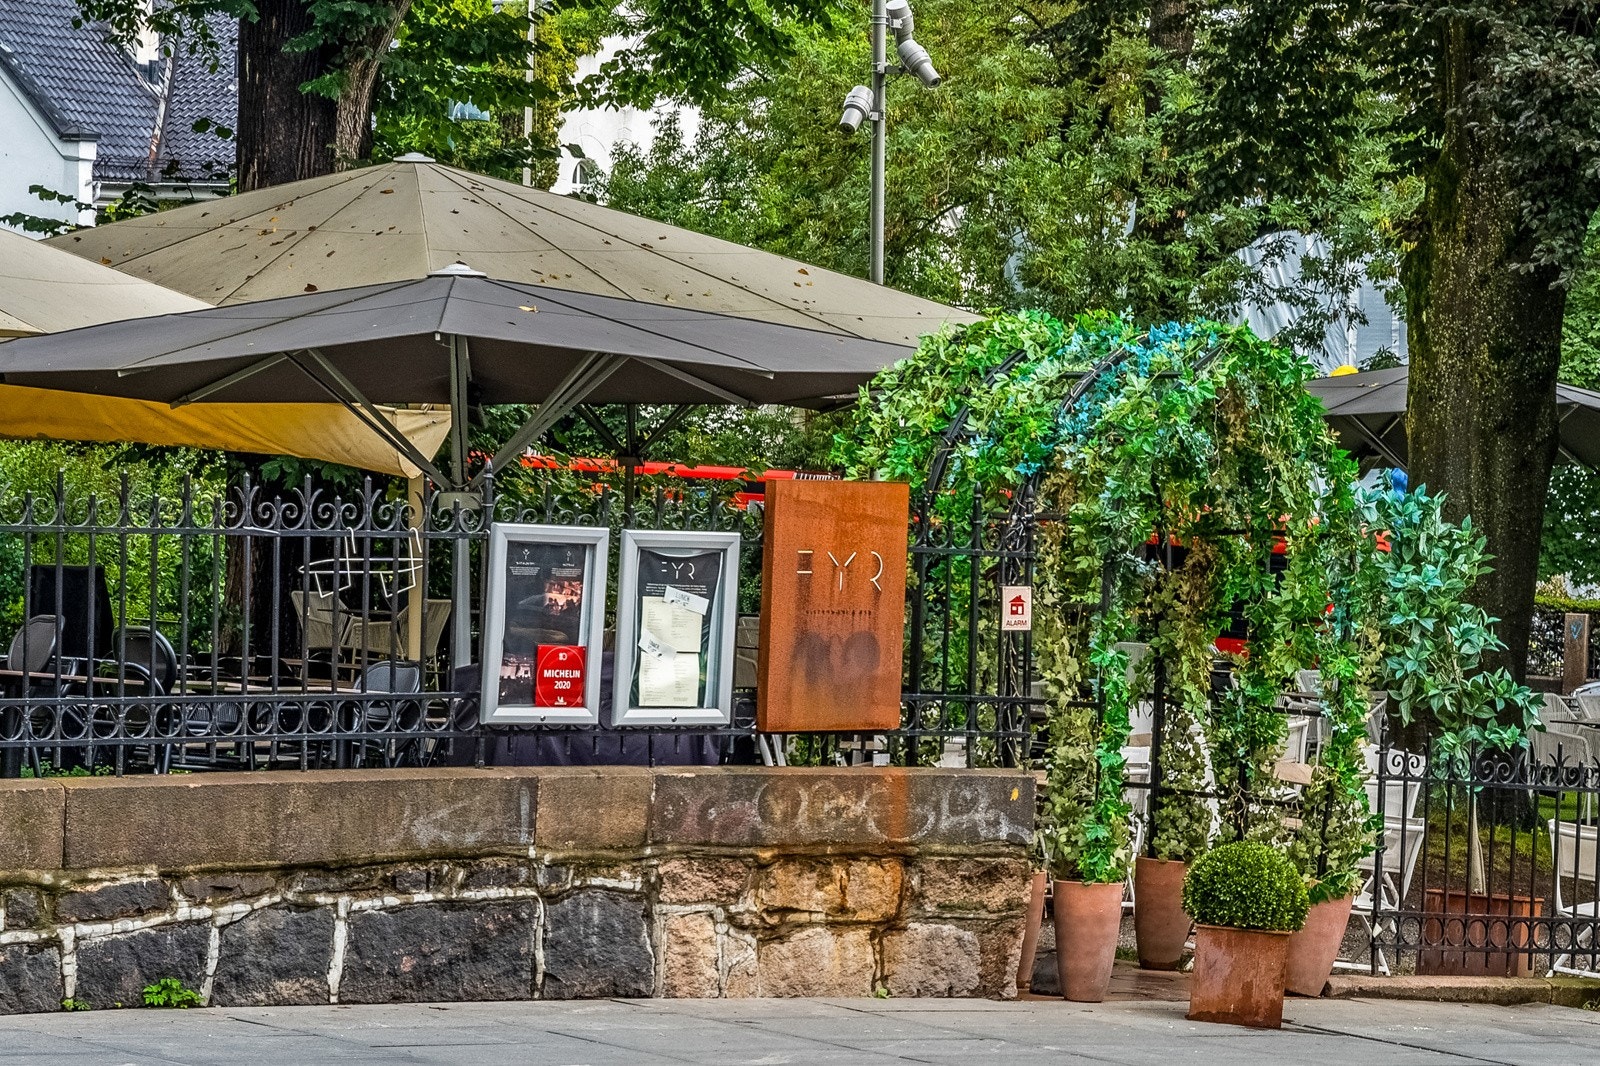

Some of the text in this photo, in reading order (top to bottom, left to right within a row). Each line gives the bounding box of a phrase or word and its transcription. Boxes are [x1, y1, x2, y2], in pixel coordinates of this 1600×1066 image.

[1006, 619, 1027, 627] ALARM
[543, 669, 581, 678] MICHELIN
[554, 680, 571, 689] 2020
